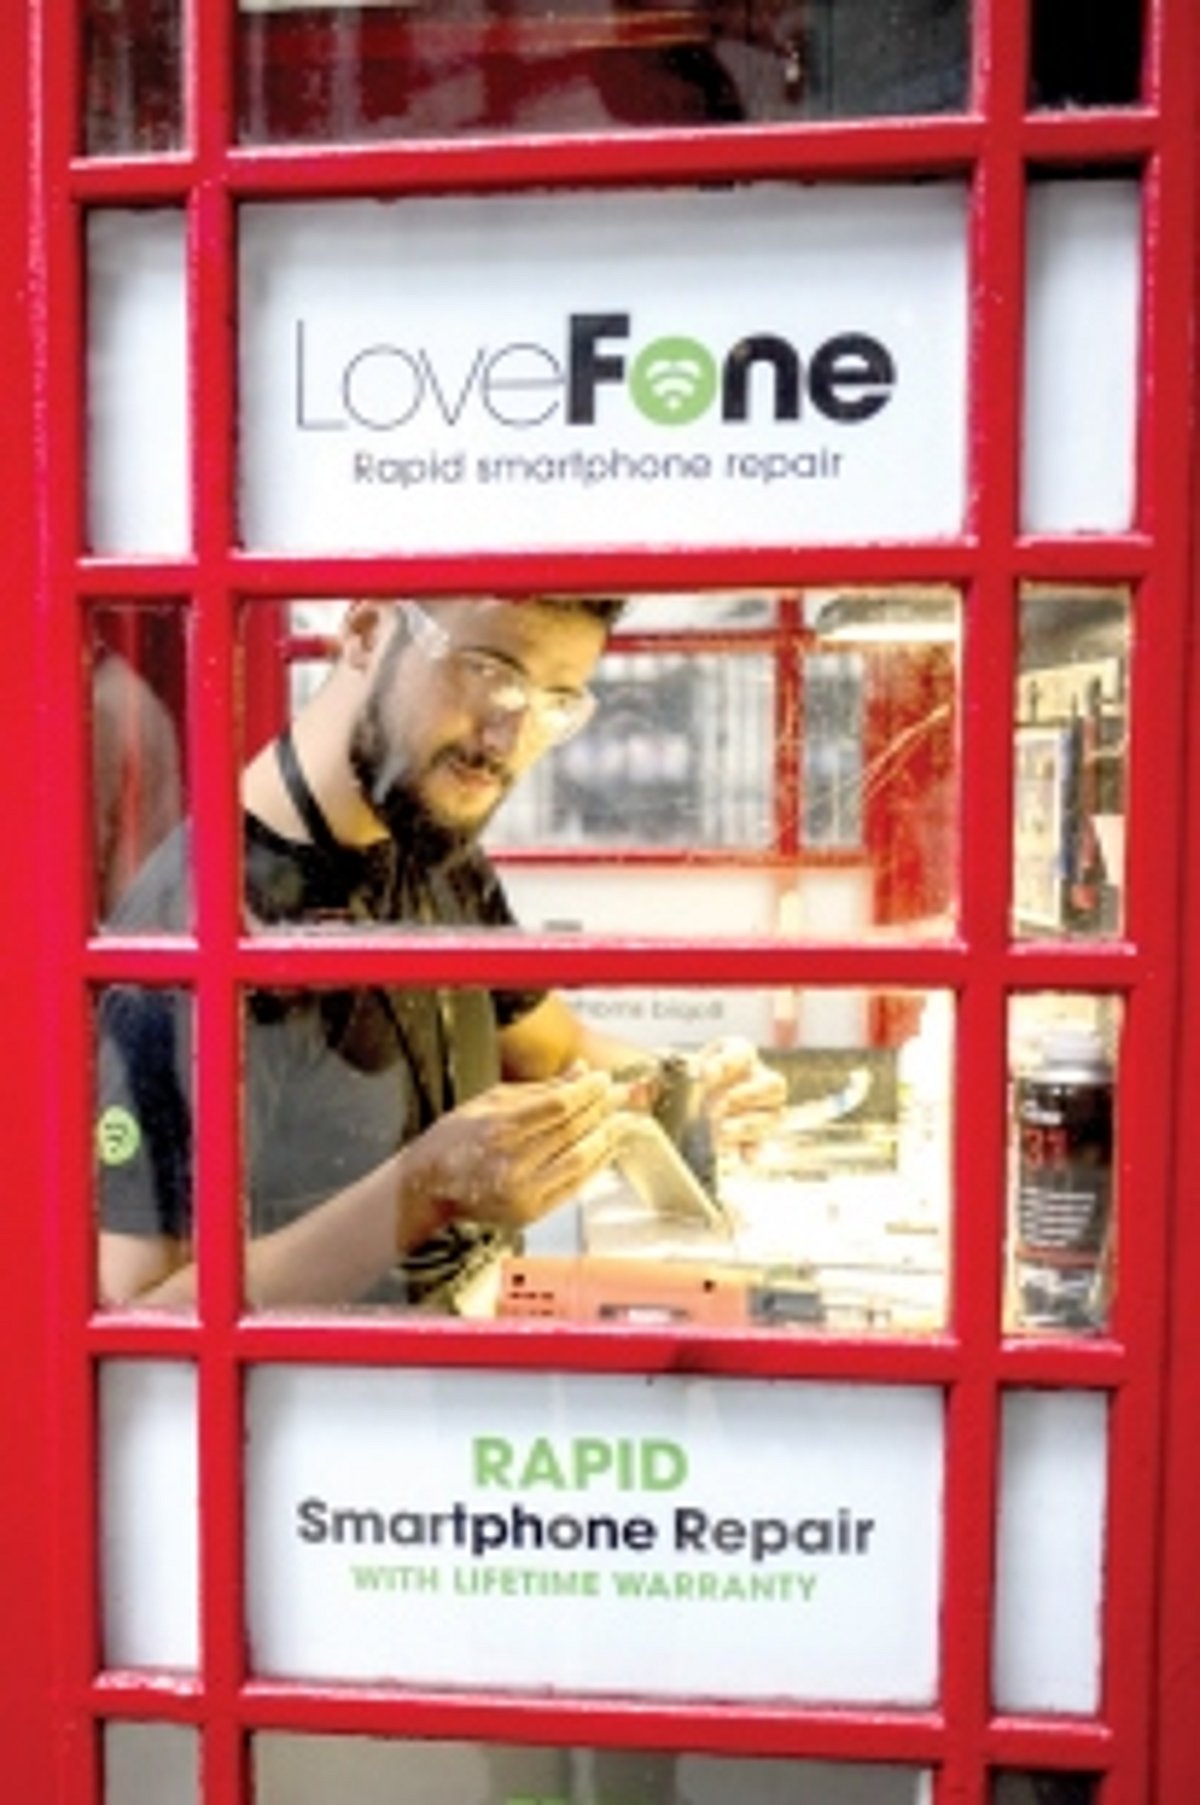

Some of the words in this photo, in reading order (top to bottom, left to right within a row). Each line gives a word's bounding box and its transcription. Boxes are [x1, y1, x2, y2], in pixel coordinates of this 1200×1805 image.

[297, 312, 898, 430] LoveFone
[353, 452, 464, 488] Rapid
[476, 449, 712, 485] smartphone
[726, 448, 844, 485] repair
[472, 1437, 688, 1492] RAPID
[297, 1499, 658, 1556] Smartphone
[673, 1507, 876, 1562] Repair
[352, 1566, 440, 1592] WITH
[453, 1570, 600, 1597] LIFETIME
[612, 1573, 817, 1601] WARRANTY
